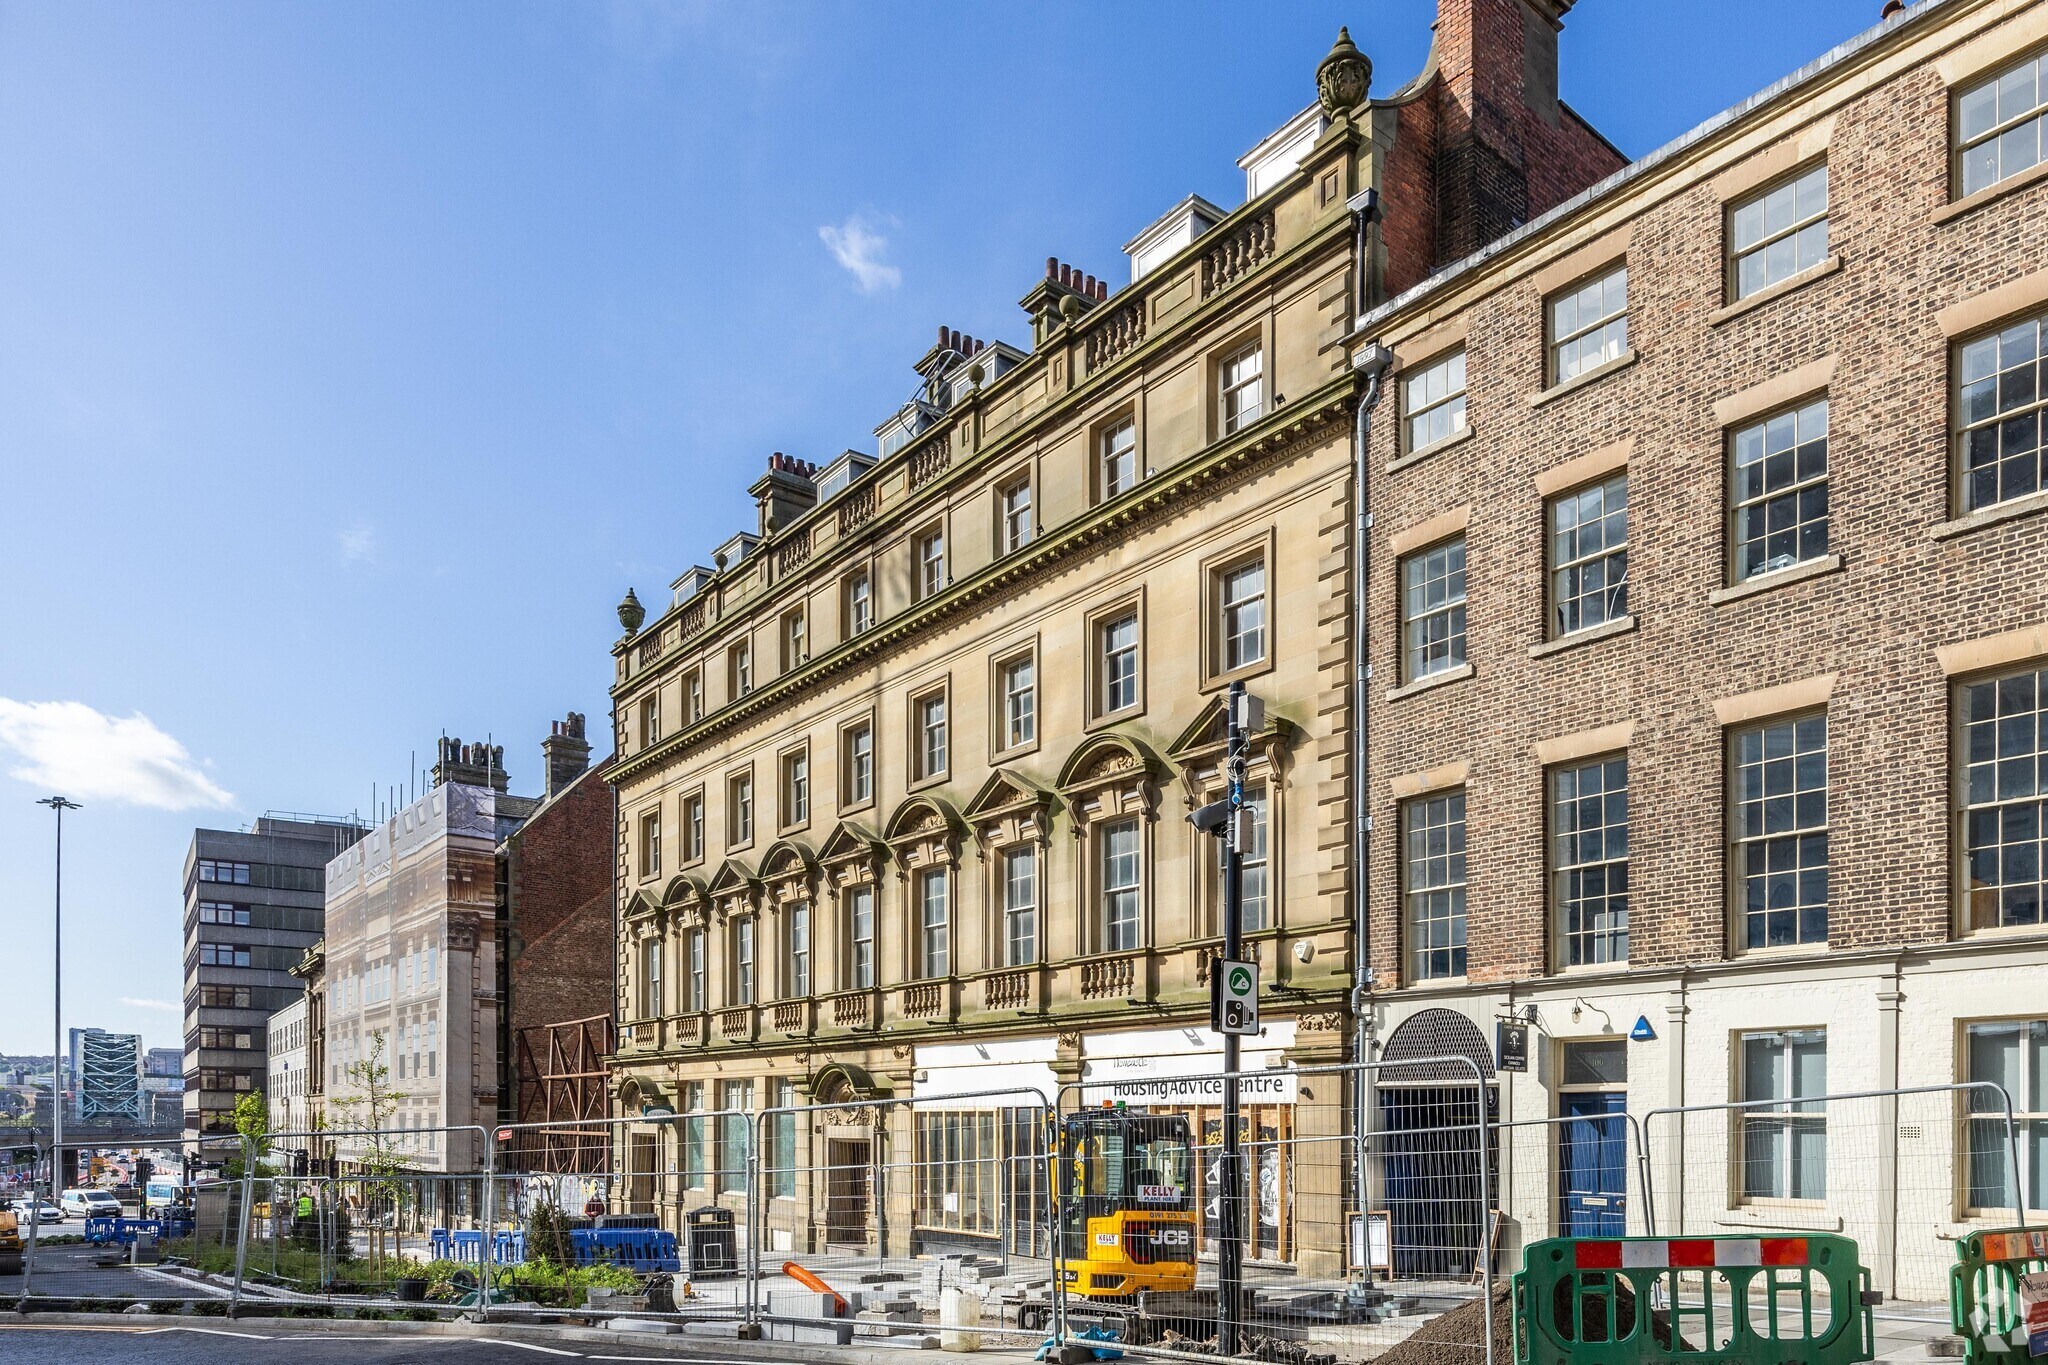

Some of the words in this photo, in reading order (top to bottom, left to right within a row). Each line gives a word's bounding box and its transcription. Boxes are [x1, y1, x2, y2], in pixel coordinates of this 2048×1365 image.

[1239, 1077, 1283, 1093] entre
[1143, 1186, 1175, 1196] KELLY
[1150, 1230, 1189, 1245] JCB
